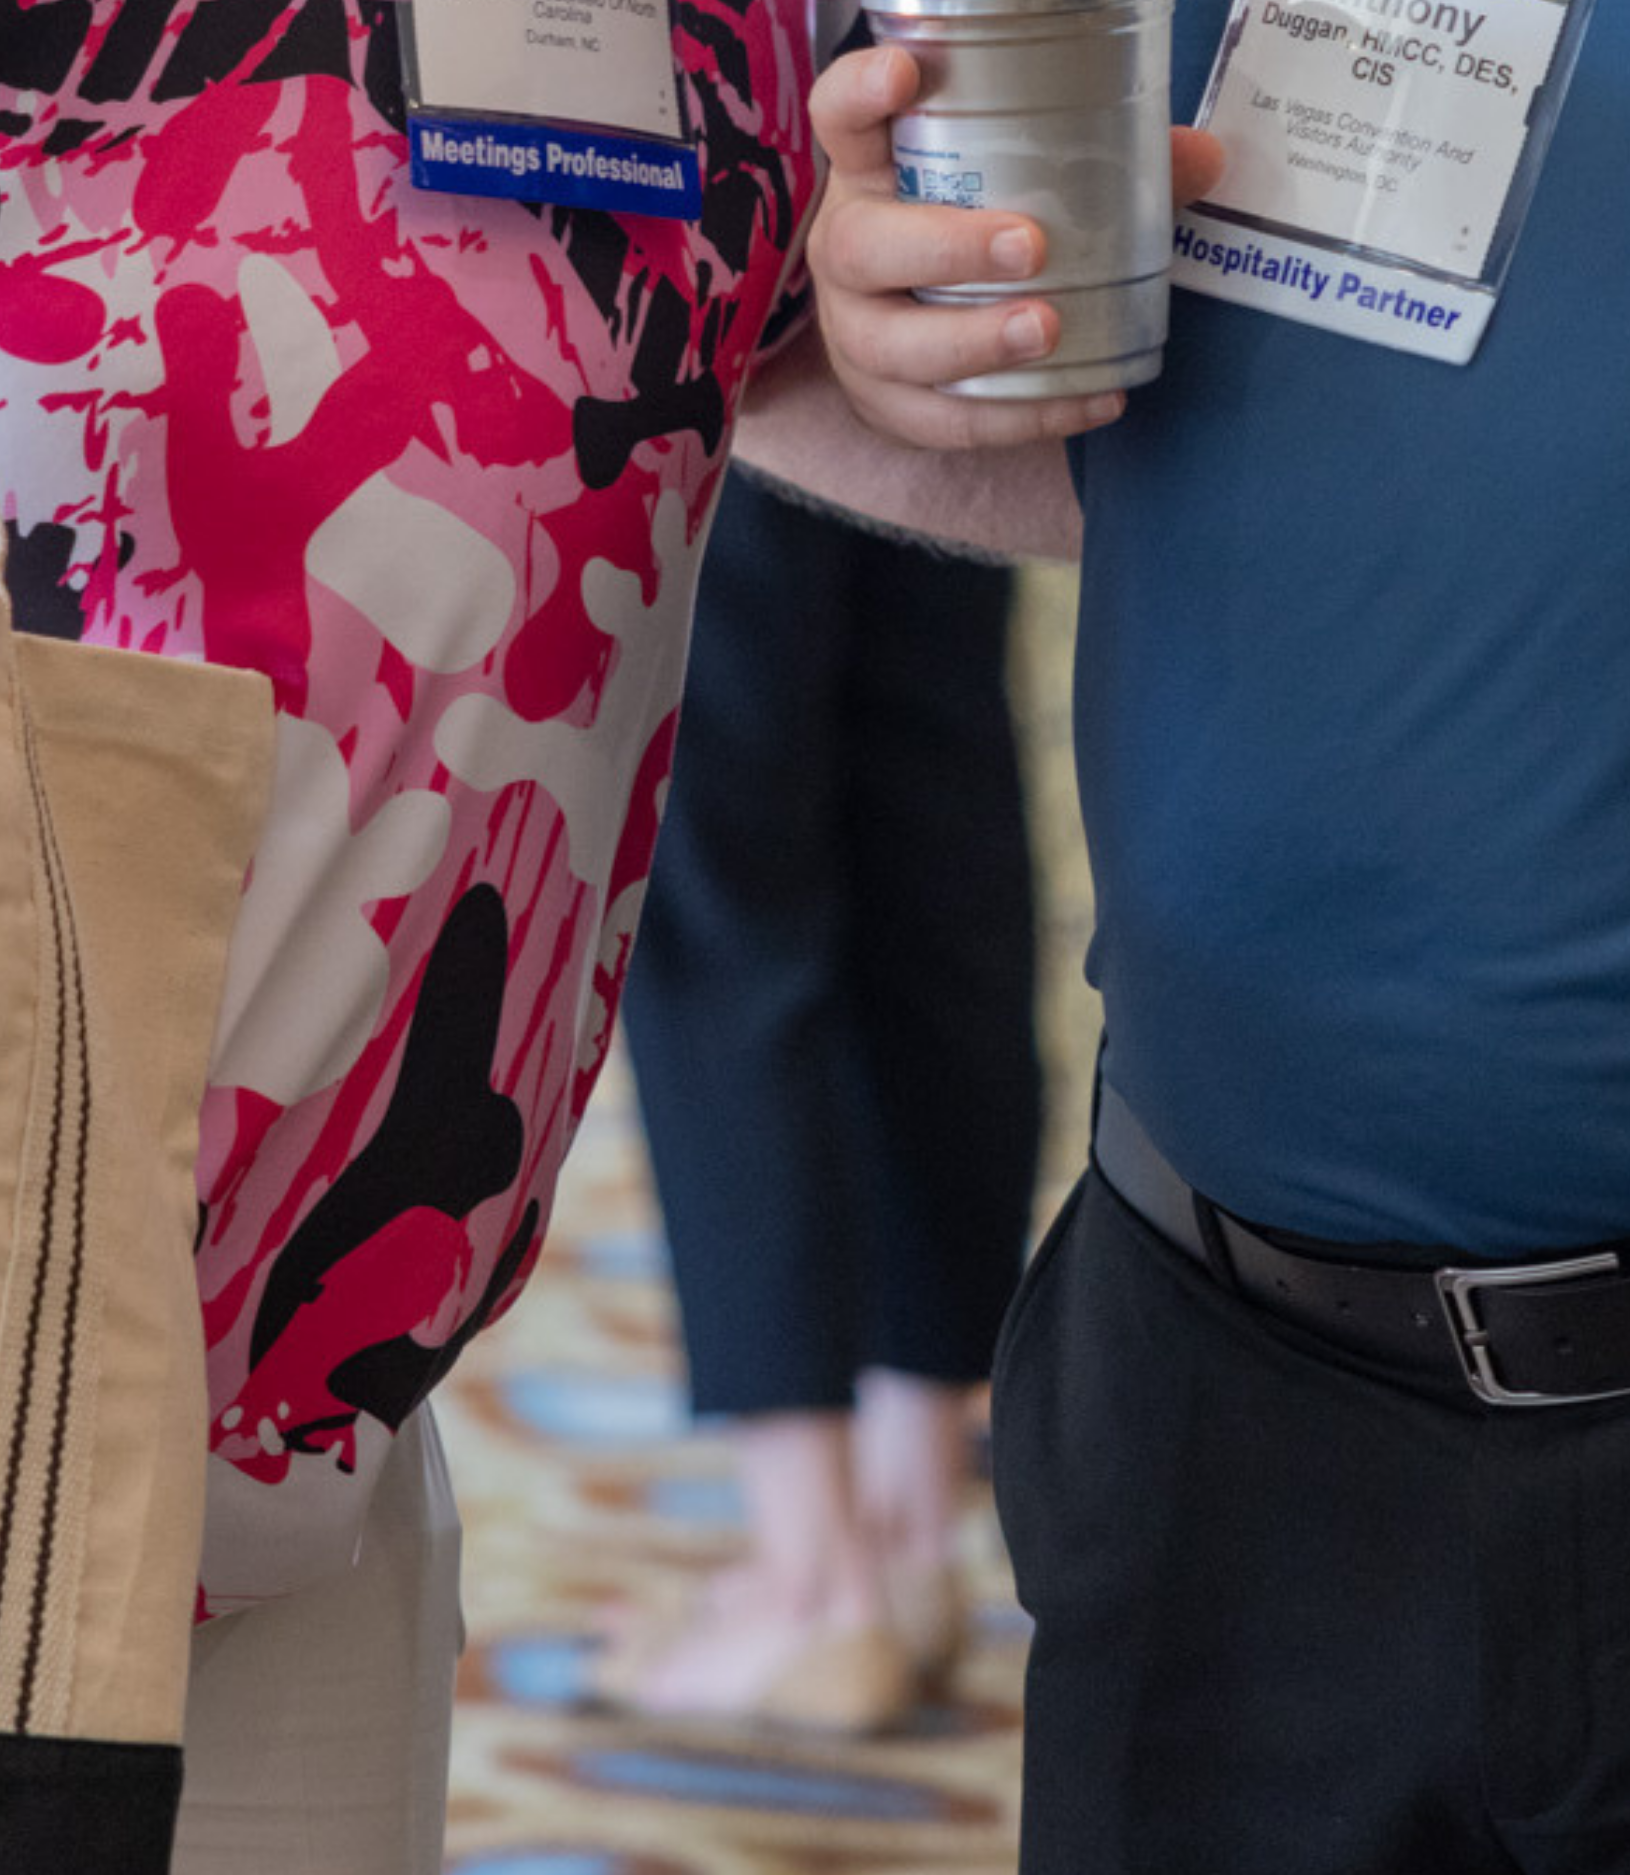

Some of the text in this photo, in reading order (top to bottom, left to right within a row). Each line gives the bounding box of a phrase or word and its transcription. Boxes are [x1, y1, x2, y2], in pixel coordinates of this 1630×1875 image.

[532, 0, 593, 25] Carolina
[1262, 1, 1354, 47] Duggan,
[1454, 51, 1519, 95] DES,
[1351, 55, 1395, 87] CIS
[420, 129, 685, 191] Meetings Professional
[1285, 97, 1334, 125] Vegas
[1436, 140, 1475, 166] And
[1286, 120, 1343, 149] Visitors
[1172, 224, 1461, 333] Hospitality Partner
